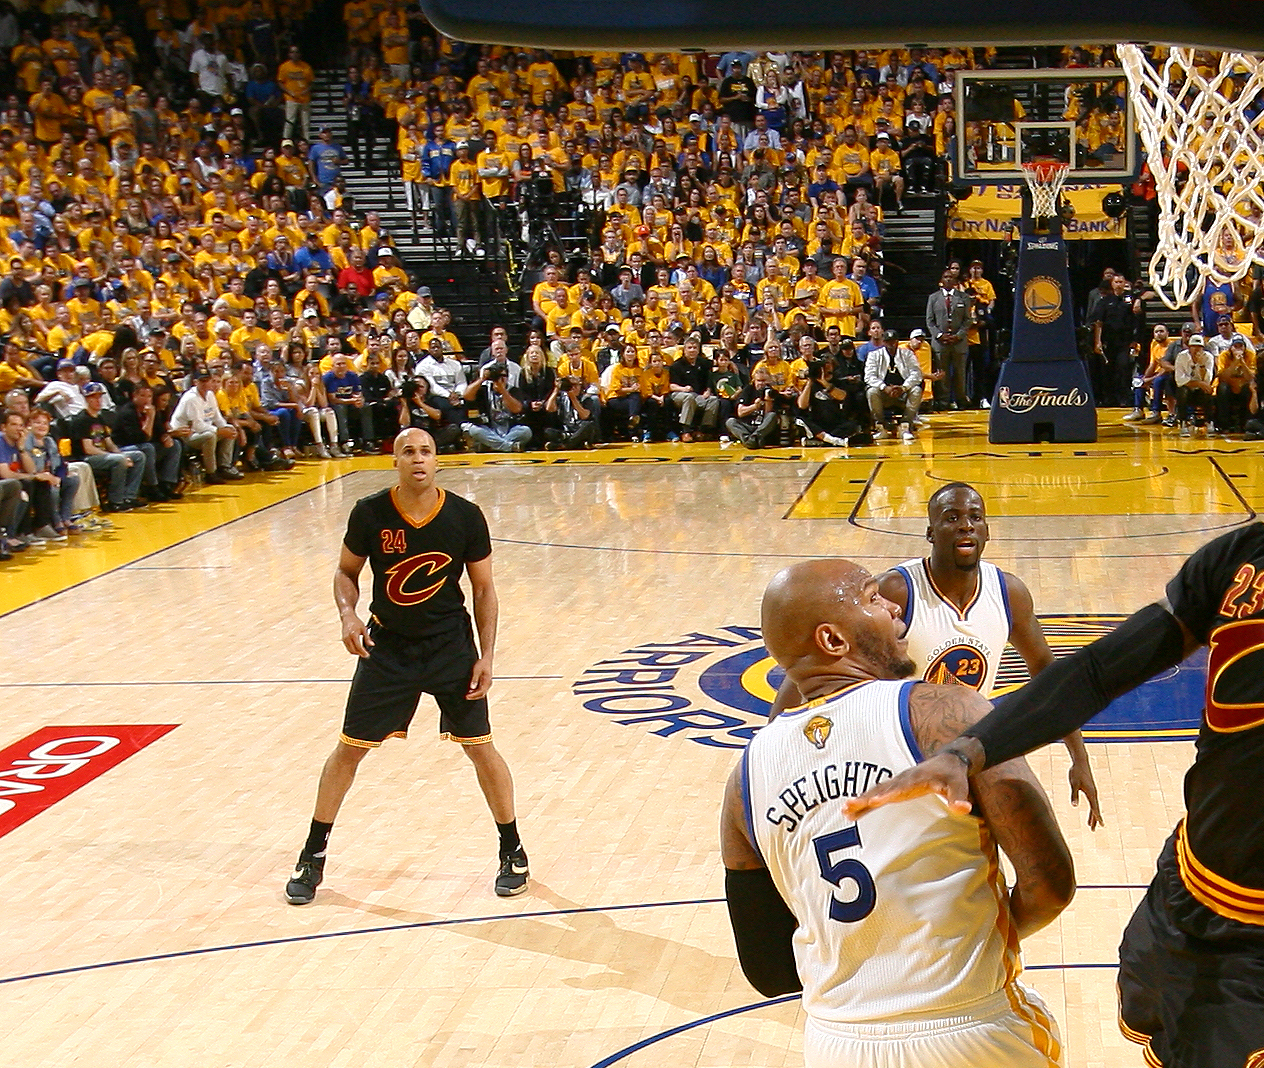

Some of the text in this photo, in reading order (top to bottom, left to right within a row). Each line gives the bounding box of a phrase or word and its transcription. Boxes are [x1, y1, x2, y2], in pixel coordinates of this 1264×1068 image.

[951, 219, 984, 232] CITY
[1067, 219, 1110, 232] BANK
[1009, 386, 1088, 413] The Finals
[381, 529, 407, 553] 24
[927, 636, 992, 662] GOLDEN STATE
[955, 658, 981, 676] 23
[812, 822, 877, 923] 5
